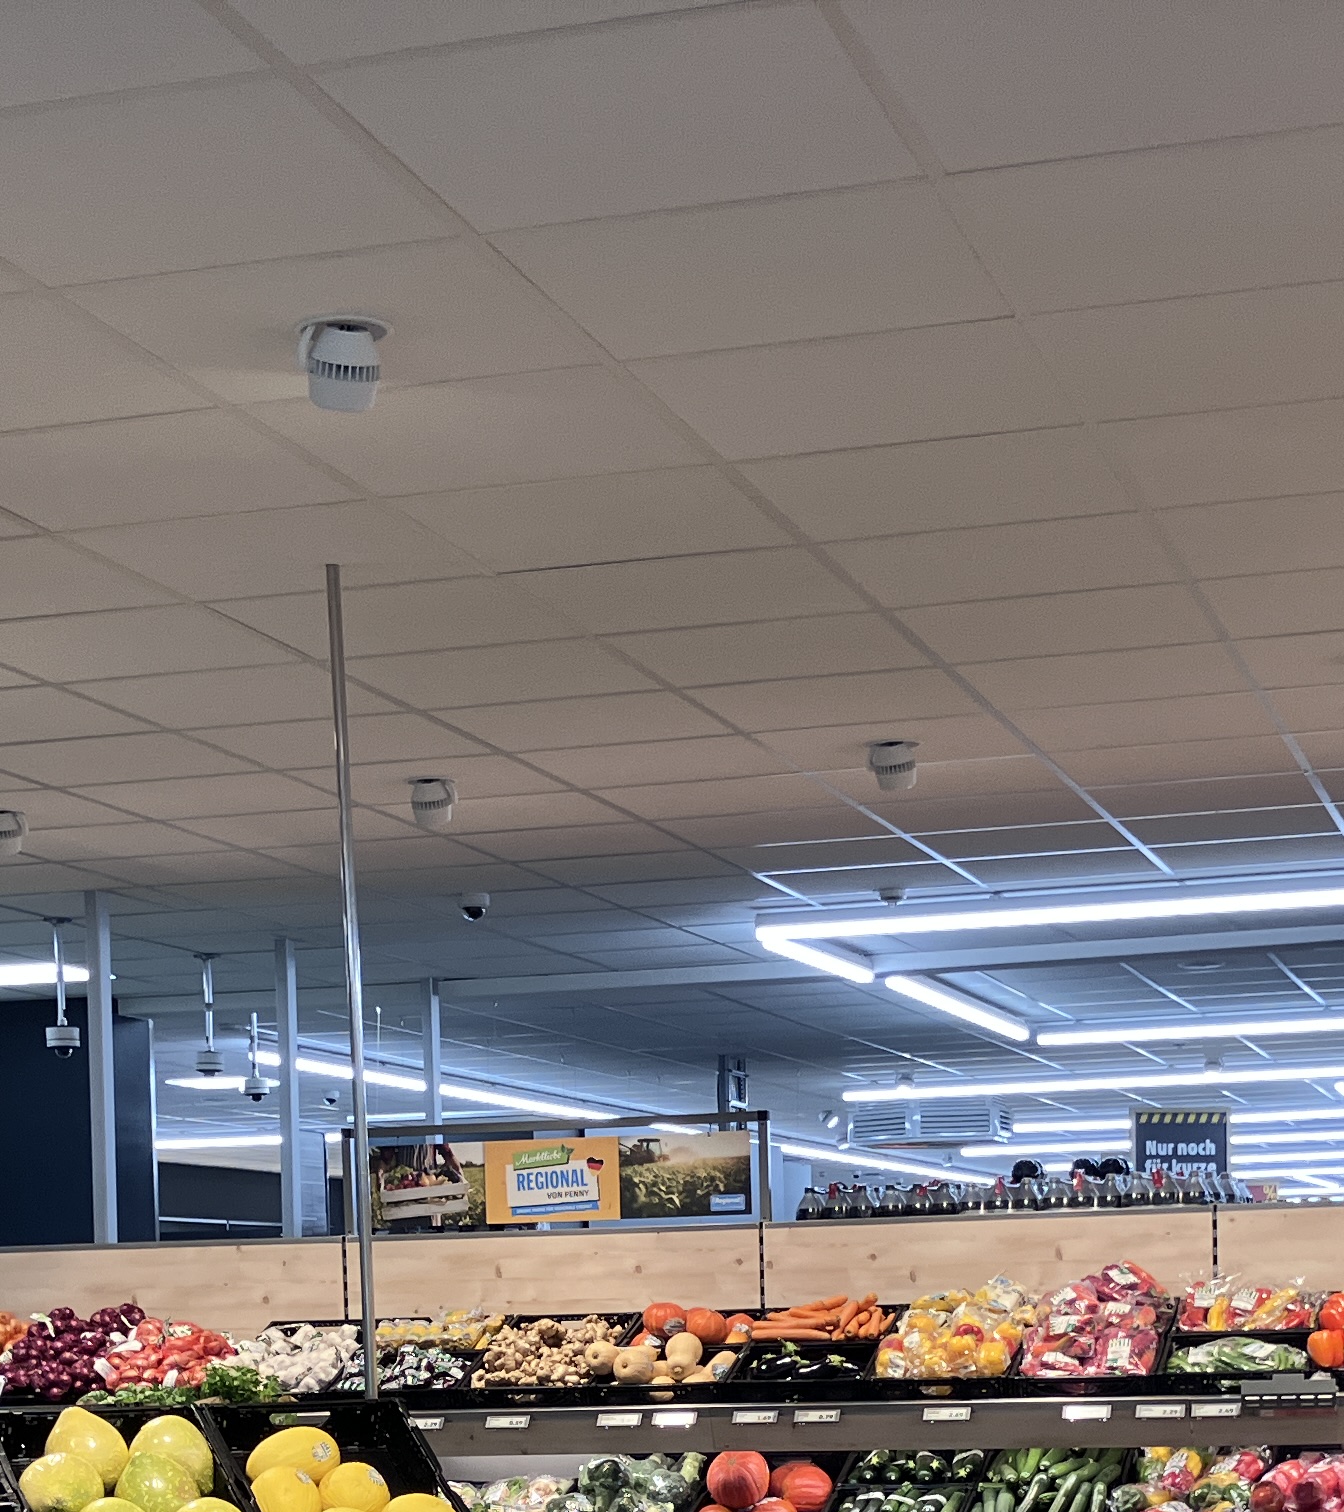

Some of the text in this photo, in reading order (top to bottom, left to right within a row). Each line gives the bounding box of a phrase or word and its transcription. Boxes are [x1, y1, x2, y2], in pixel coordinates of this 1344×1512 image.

[1145, 1139, 1216, 1156] Nur noch
[516, 1168, 588, 1191] REGIONAL
[564, 1190, 590, 1198] PENNY
